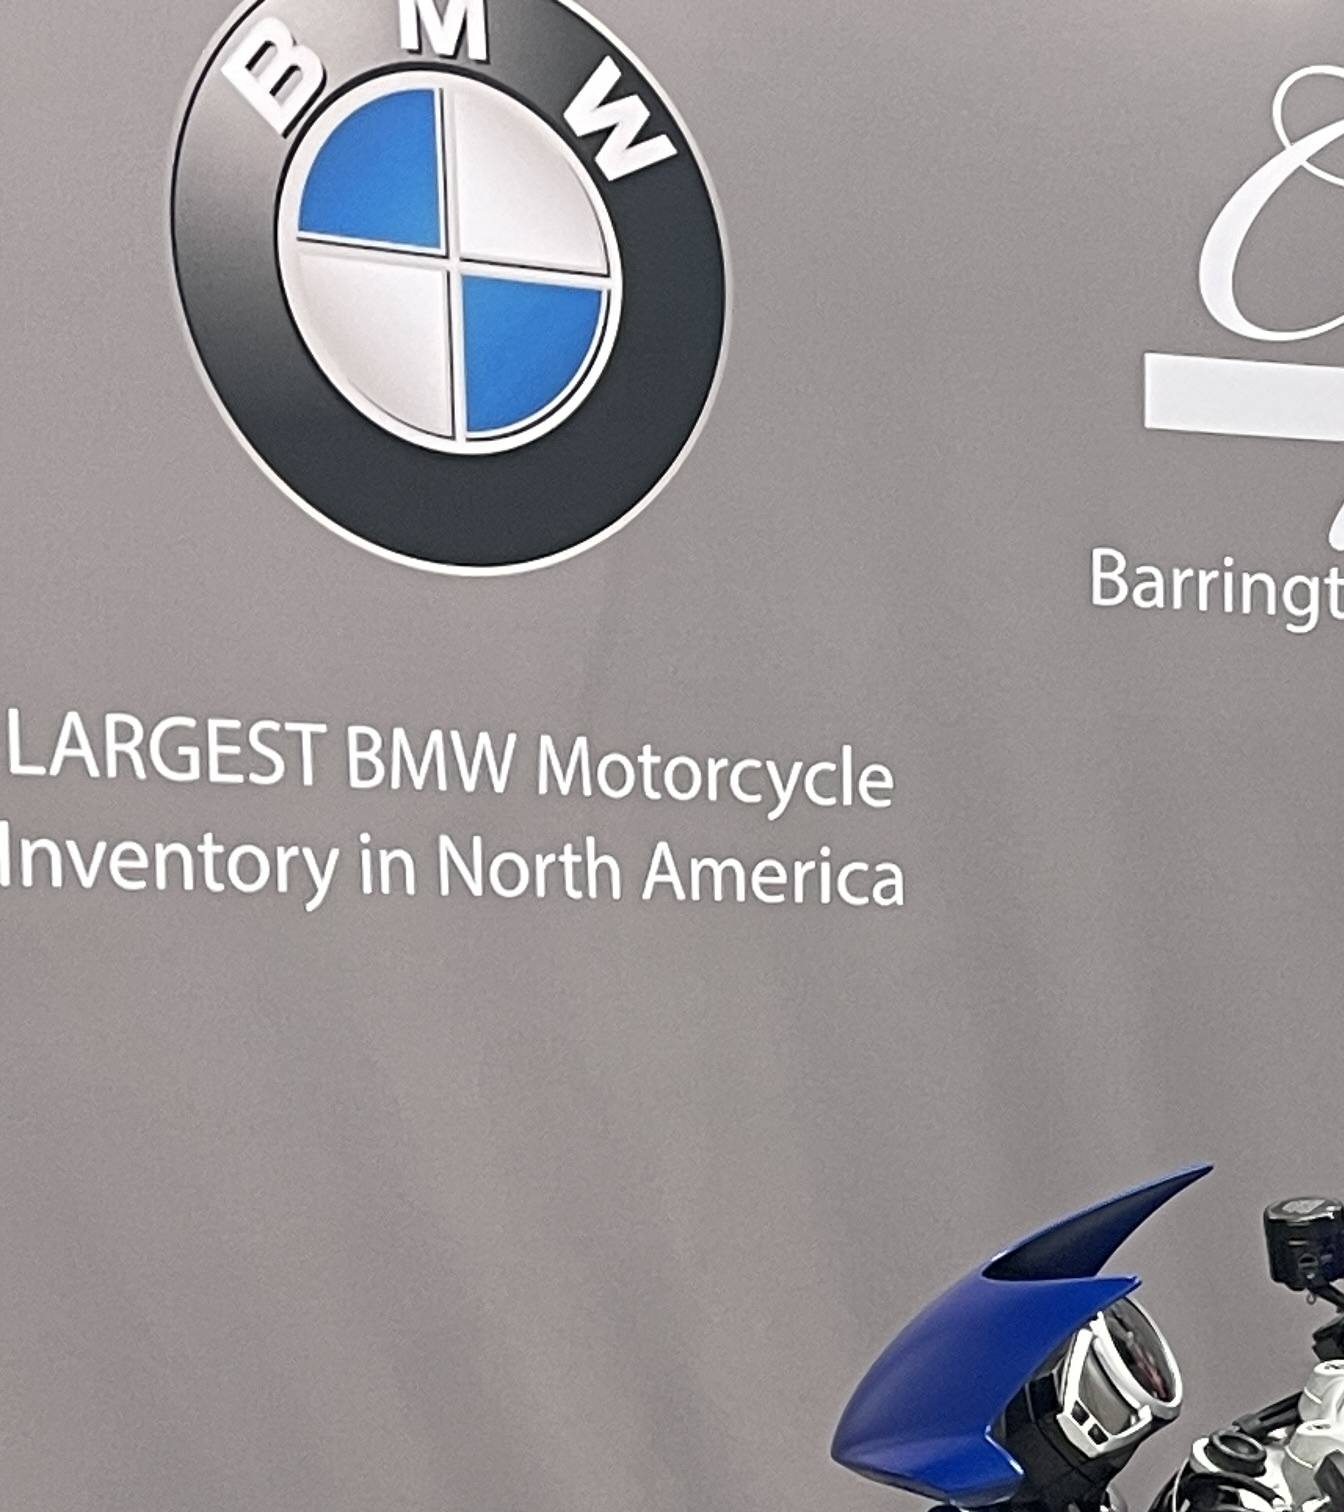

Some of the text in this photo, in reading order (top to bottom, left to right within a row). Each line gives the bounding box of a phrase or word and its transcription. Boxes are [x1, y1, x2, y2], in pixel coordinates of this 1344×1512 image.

[222, 0, 678, 181] BMW
[8, 708, 894, 821] LARGEST BMW Motorcycle
[0, 820, 904, 912] Inventory in North America
